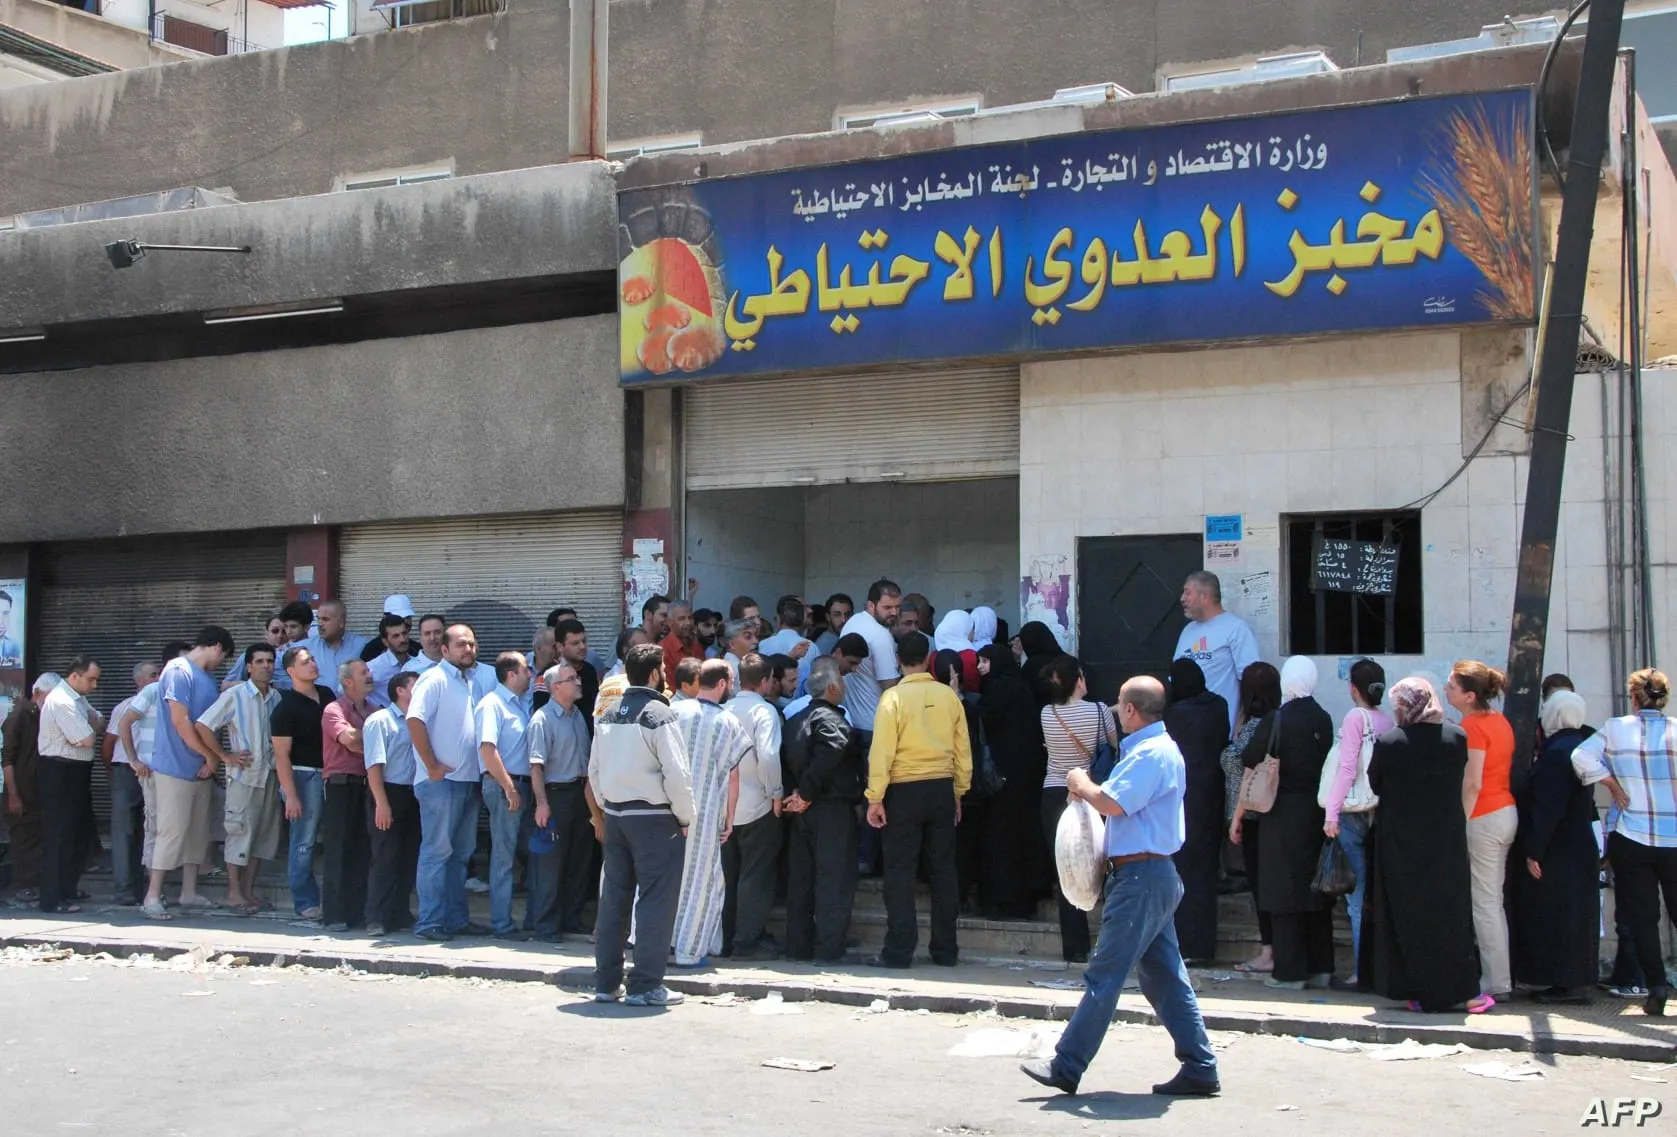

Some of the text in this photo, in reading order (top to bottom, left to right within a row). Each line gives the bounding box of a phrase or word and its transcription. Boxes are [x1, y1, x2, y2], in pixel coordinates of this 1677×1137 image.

[1165, 140, 1261, 177] الاقتصاد
[1269, 136, 1328, 171] وزارة
[900, 172, 983, 212] المخابز
[990, 165, 1040, 199] لجنة
[1061, 154, 1137, 192] التجارة
[792, 181, 894, 223] الاحتياطية
[723, 180, 1444, 352] مخبز العدوي الاحتياطي
